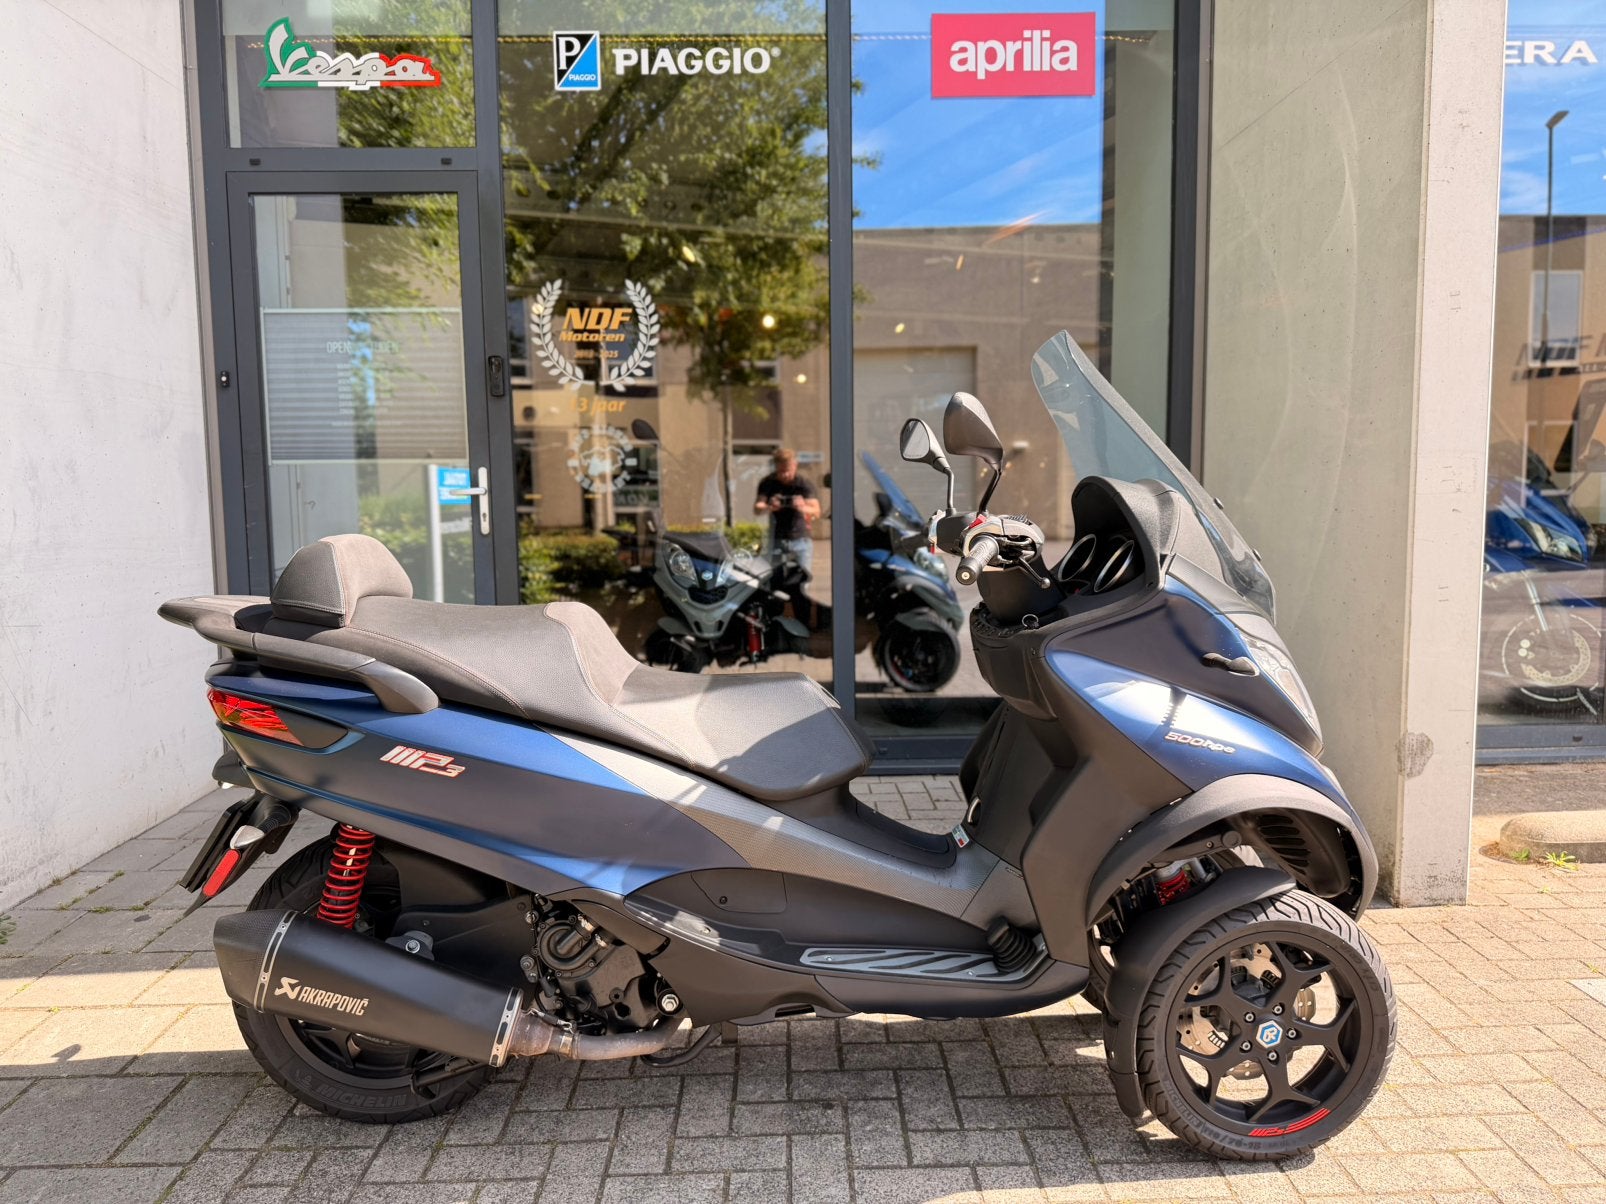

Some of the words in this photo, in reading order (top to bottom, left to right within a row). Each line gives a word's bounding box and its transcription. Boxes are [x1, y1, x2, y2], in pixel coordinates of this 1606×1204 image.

[262, 20, 440, 88] Vespa
[949, 29, 1078, 80] aprilia
[562, 307, 633, 330] NDF
[560, 330, 626, 342] Motoren
[590, 397, 627, 416] jaar
[379, 745, 466, 778] MP3
[316, 1083, 408, 1108] MICHELIN
